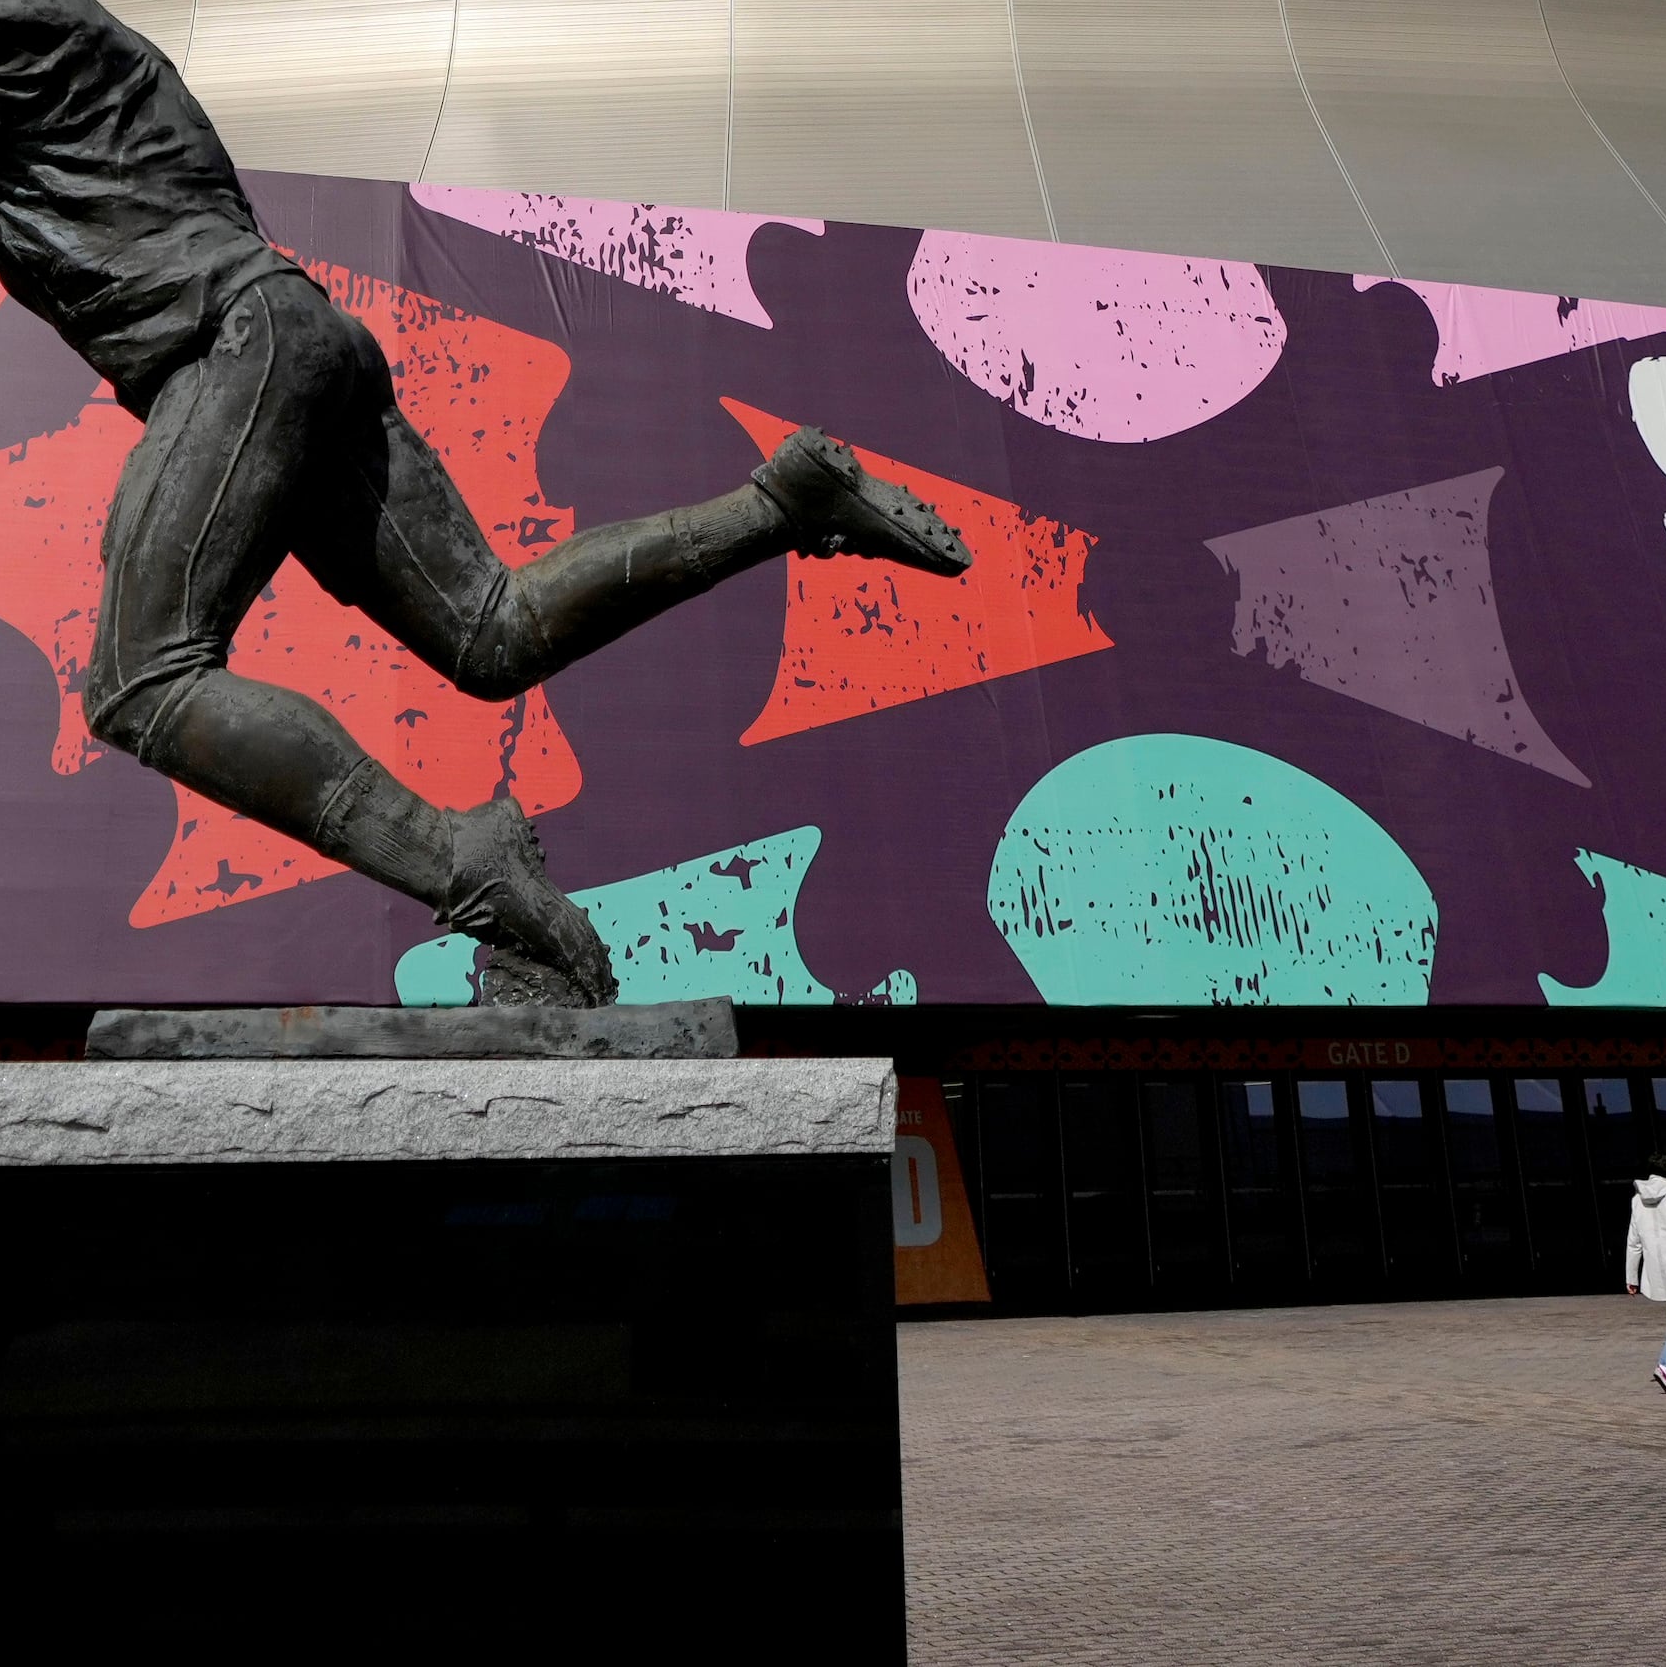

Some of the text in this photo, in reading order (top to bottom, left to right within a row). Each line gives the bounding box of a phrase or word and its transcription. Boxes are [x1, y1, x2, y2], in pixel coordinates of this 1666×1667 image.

[1328, 1041, 1410, 1065] GATE D
[898, 1110, 924, 1126] ATE
[891, 1135, 943, 1247] D
